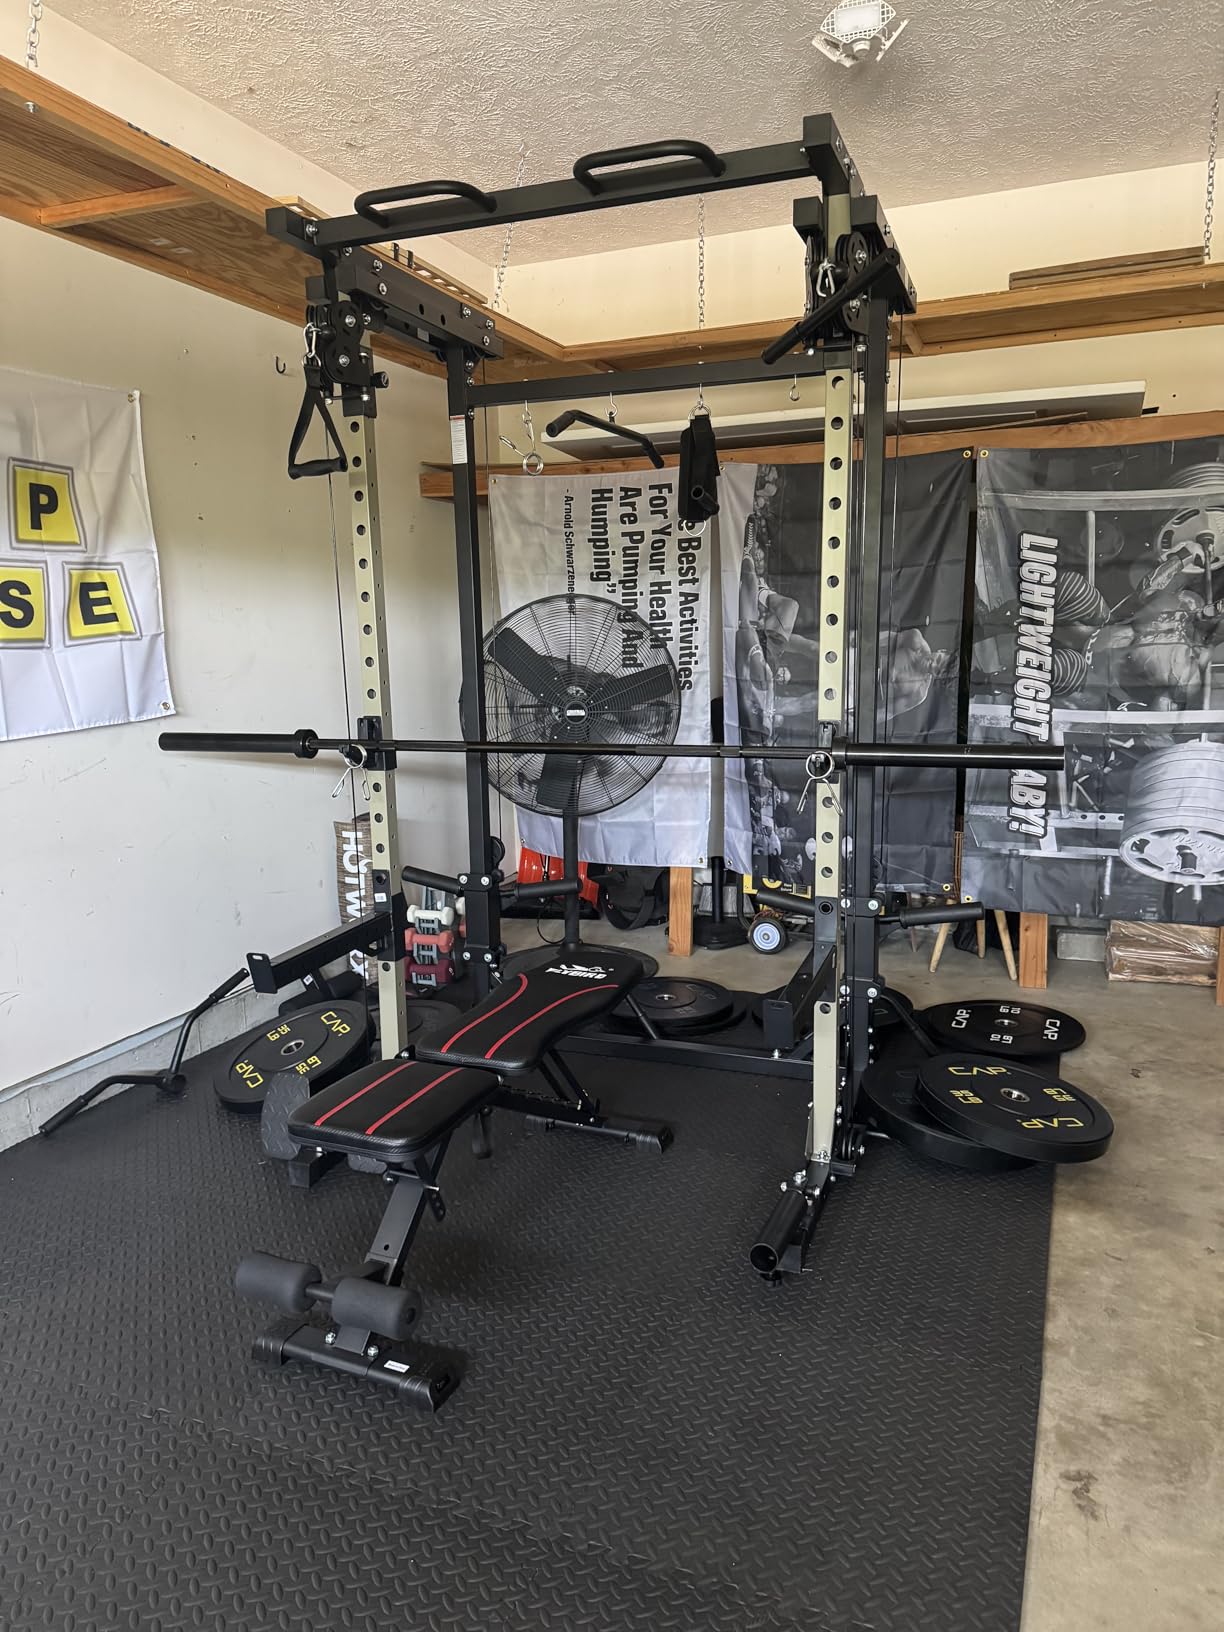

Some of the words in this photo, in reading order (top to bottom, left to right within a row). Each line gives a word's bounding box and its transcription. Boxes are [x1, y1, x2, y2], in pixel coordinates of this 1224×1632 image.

[28, 482, 59, 531] P
[563, 495, 574, 529] Arnold
[619, 486, 643, 525] Are
[648, 482, 673, 518] For
[649, 521, 673, 575] Your
[678, 537, 701, 586] Best
[563, 531, 576, 616] Schwarzeneger
[616, 531, 645, 623] Pumping
[648, 581, 673, 649] Health
[622, 629, 644, 668] And
[677, 591, 700, 691] Activities
[1012, 533, 1057, 742] LIGHTWEIGHT
[1008, 768, 1048, 838] ABY!
[320, 1011, 351, 1036] CAP
[951, 1009, 971, 1029] CAP
[1043, 1019, 1060, 1040] CAP
[235, 1060, 264, 1089] CAP
[948, 1066, 1008, 1075] CAP
[1020, 1117, 1084, 1129] CAP
